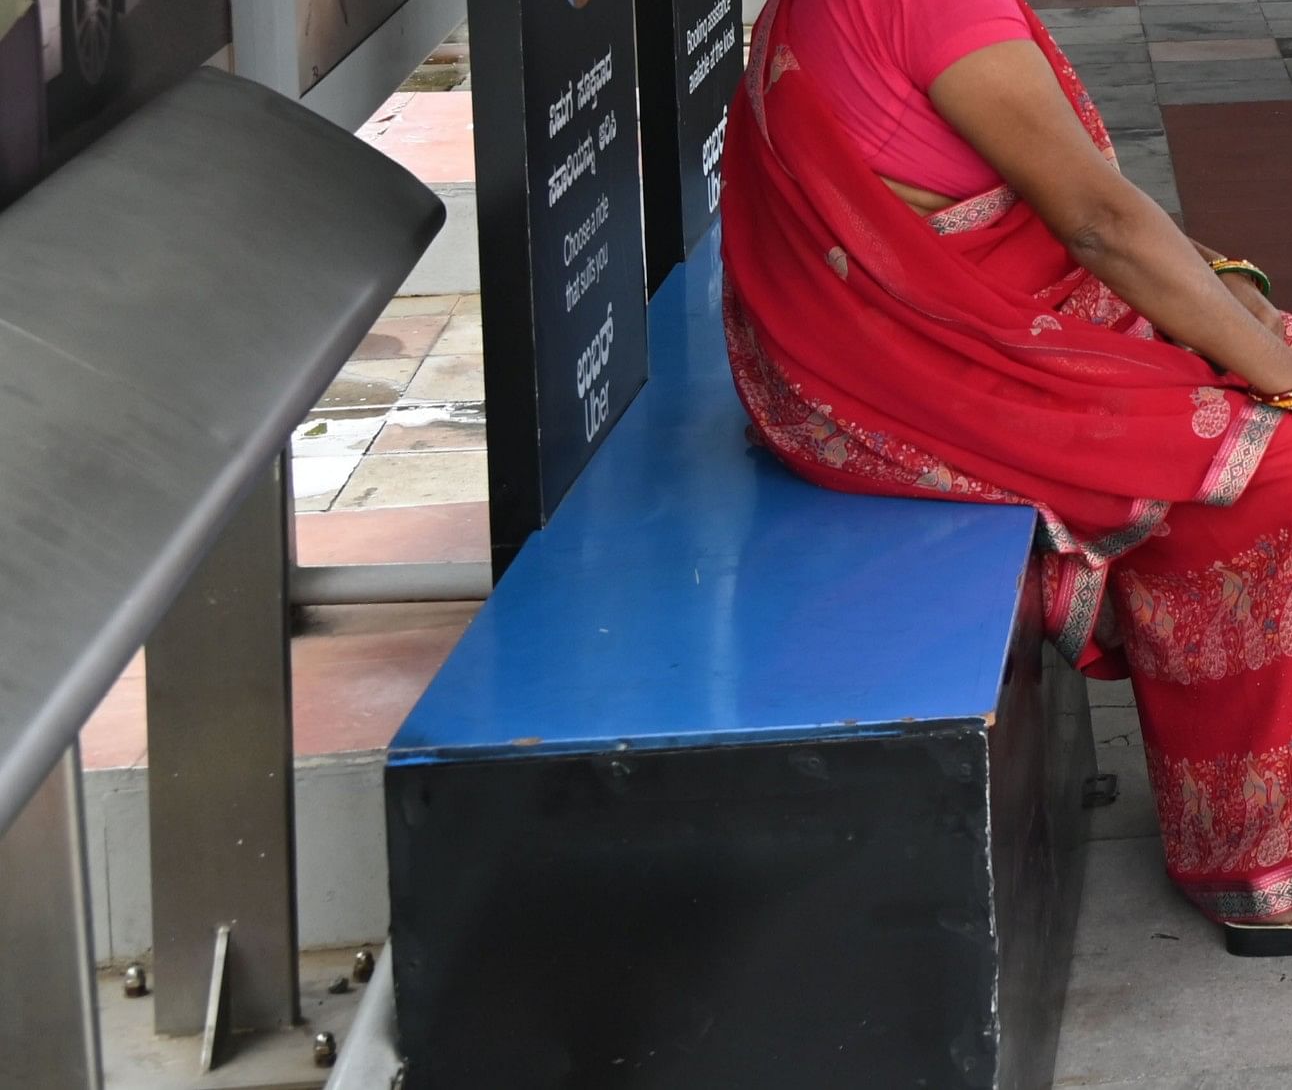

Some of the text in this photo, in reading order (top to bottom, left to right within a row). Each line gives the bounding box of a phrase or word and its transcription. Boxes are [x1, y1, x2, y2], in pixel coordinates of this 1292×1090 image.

[686, 15, 708, 55] Booking
[688, 21, 736, 95] available at the kiosk
[563, 192, 609, 267] Choose a ride
[565, 241, 609, 313] that suits you
[576, 300, 614, 399] ಉಬರ್
[584, 378, 610, 444] Uber
